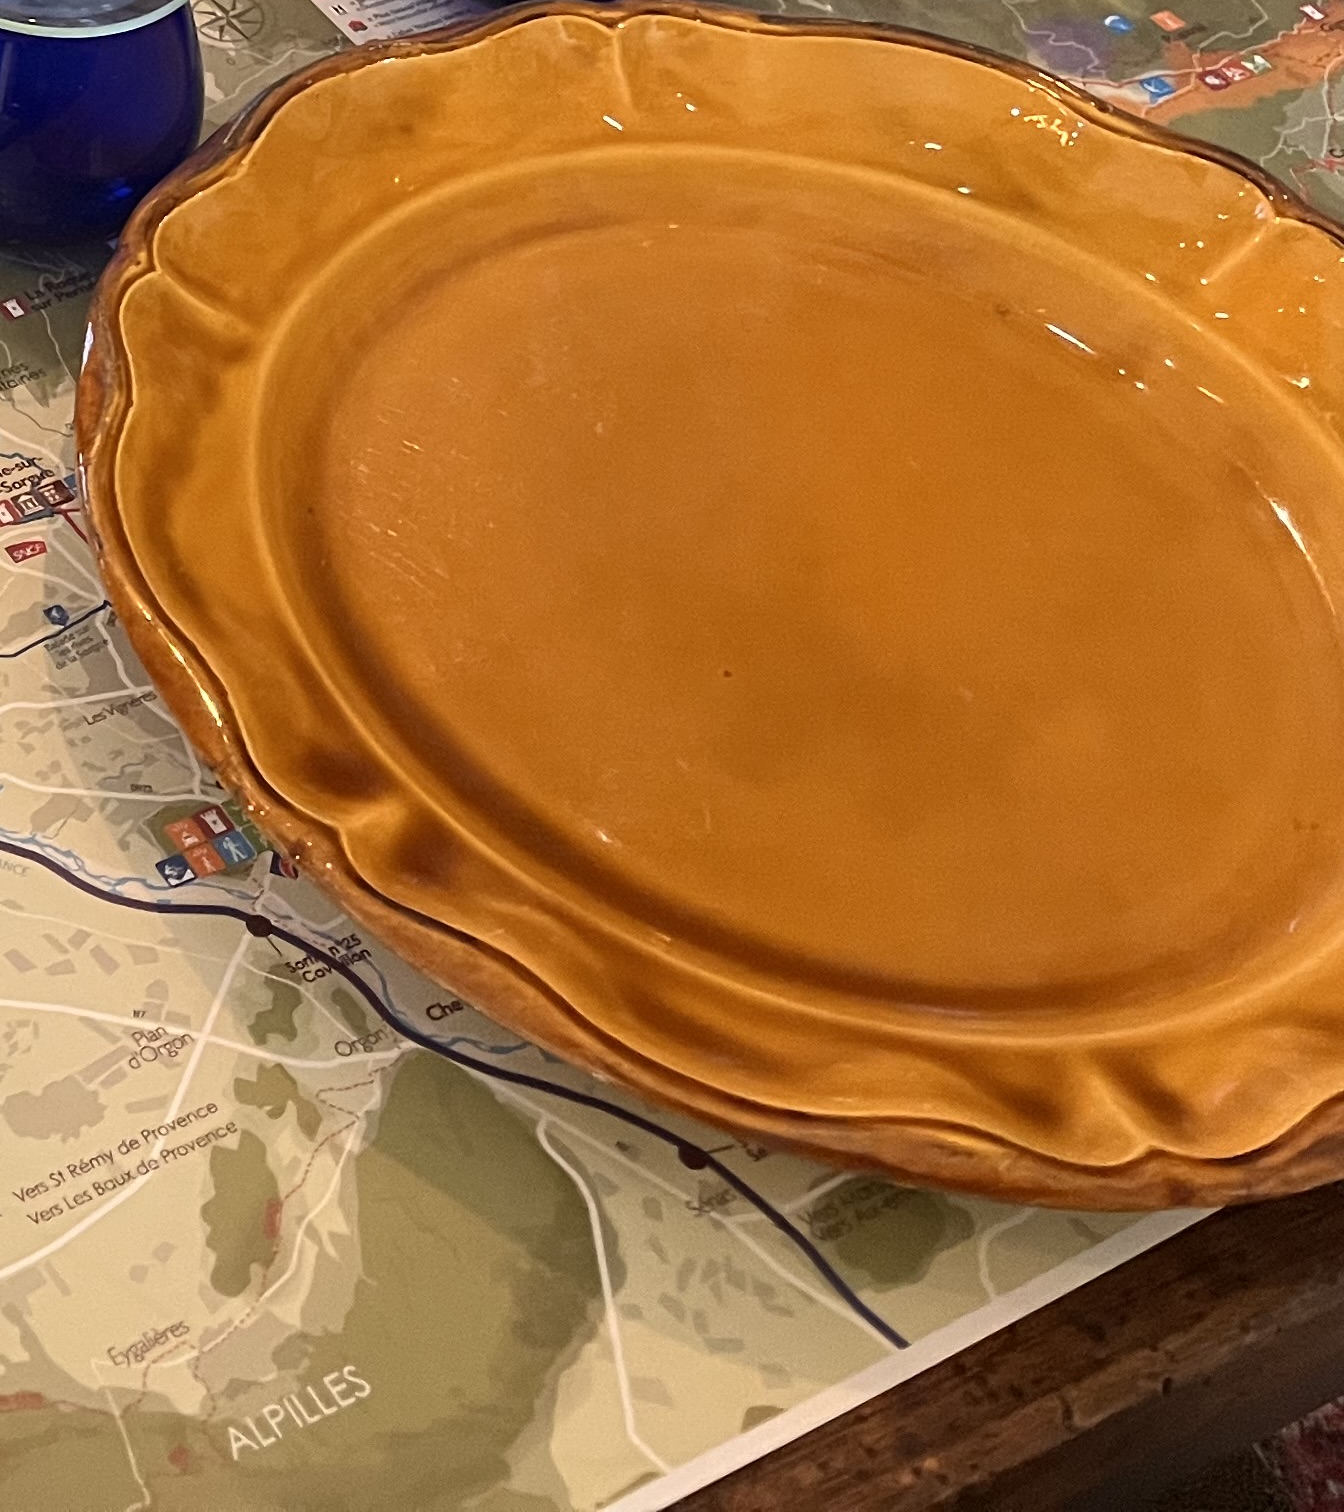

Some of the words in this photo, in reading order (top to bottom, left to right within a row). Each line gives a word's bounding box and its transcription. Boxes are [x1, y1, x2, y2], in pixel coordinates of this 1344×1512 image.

[128, 1033, 195, 1069] d'Orgon
[131, 1026, 169, 1047] Plan
[335, 1028, 389, 1057] Orgon
[12, 1182, 49, 1203] Vers
[49, 1170, 67, 1188] St
[66, 1149, 115, 1179] Rémy
[117, 1139, 141, 1156] de
[141, 1102, 219, 1144] Provence
[27, 1203, 64, 1225] Vers
[63, 1191, 93, 1211] Les
[92, 1169, 136, 1196] Baux
[136, 1158, 160, 1176] de
[159, 1120, 238, 1164] Provence
[107, 1320, 190, 1368] Eygalières
[228, 1365, 372, 1461] ALPILLES
